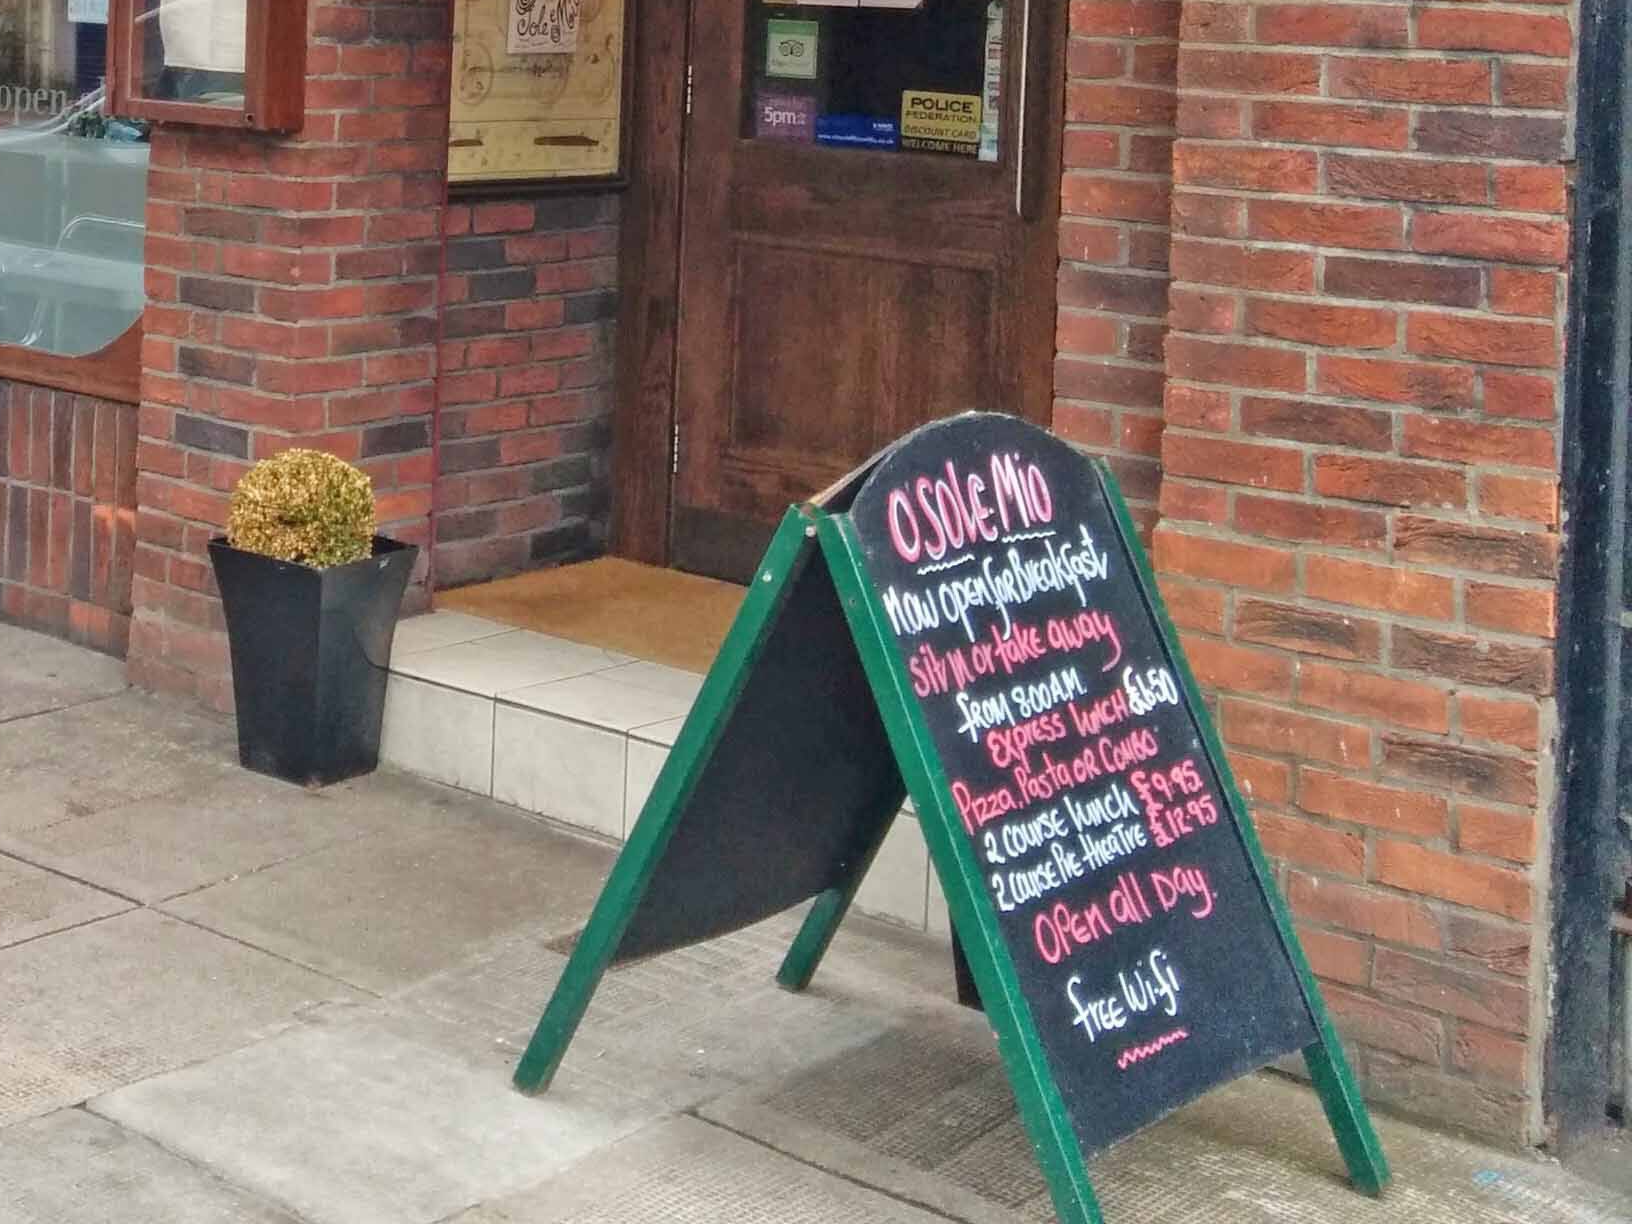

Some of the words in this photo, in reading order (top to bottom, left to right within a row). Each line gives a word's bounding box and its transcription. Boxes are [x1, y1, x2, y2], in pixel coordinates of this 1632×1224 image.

[910, 96, 974, 114] POLICE
[763, 106, 798, 127] 5pm
[904, 110, 977, 125] FEDERATION
[983, 831, 1007, 865] 2
[991, 871, 1015, 913] 2
